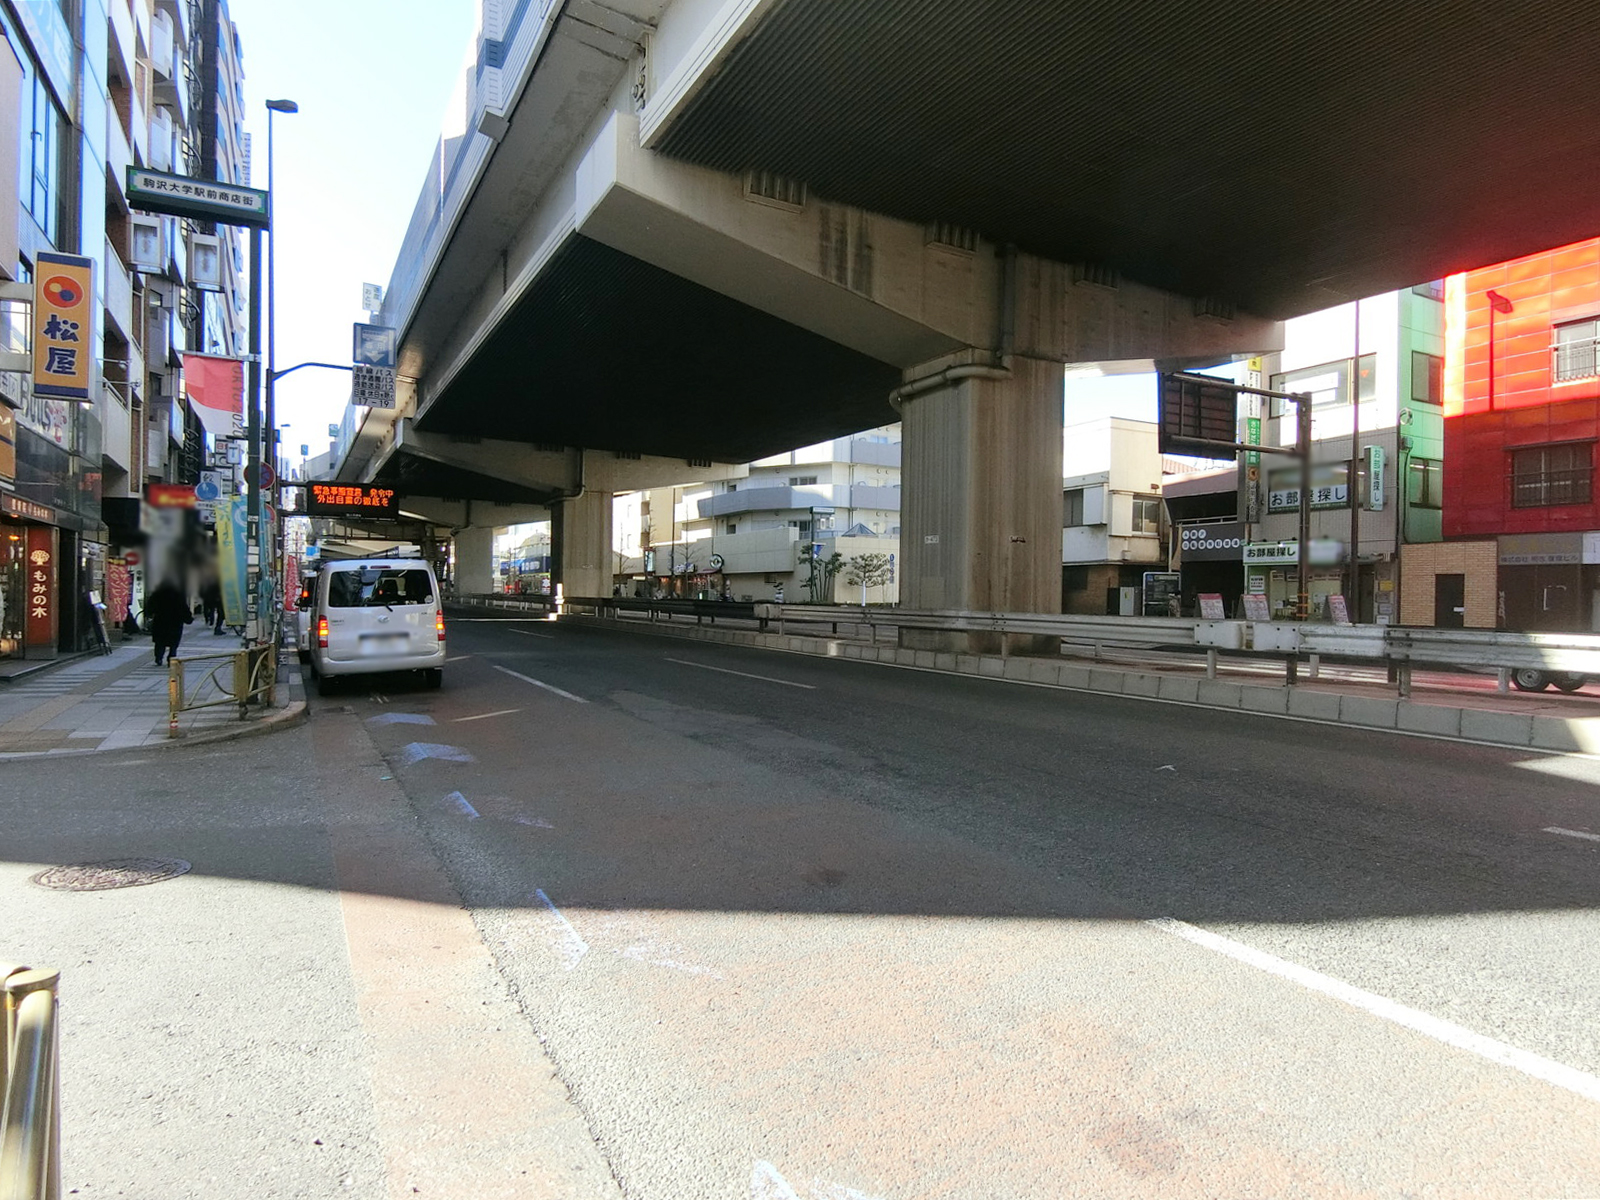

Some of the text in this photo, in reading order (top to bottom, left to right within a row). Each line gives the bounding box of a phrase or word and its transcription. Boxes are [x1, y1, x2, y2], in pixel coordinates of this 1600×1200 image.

[142, 177, 254, 206] 駒沢大学駅前商店街
[43, 314, 81, 376] 松屋
[312, 485, 394, 498] 緊急事態宣言 発令中
[1373, 449, 1381, 502] お部屋探し
[1246, 547, 1296, 558] お部屋探し
[32, 571, 48, 618] もみの木
